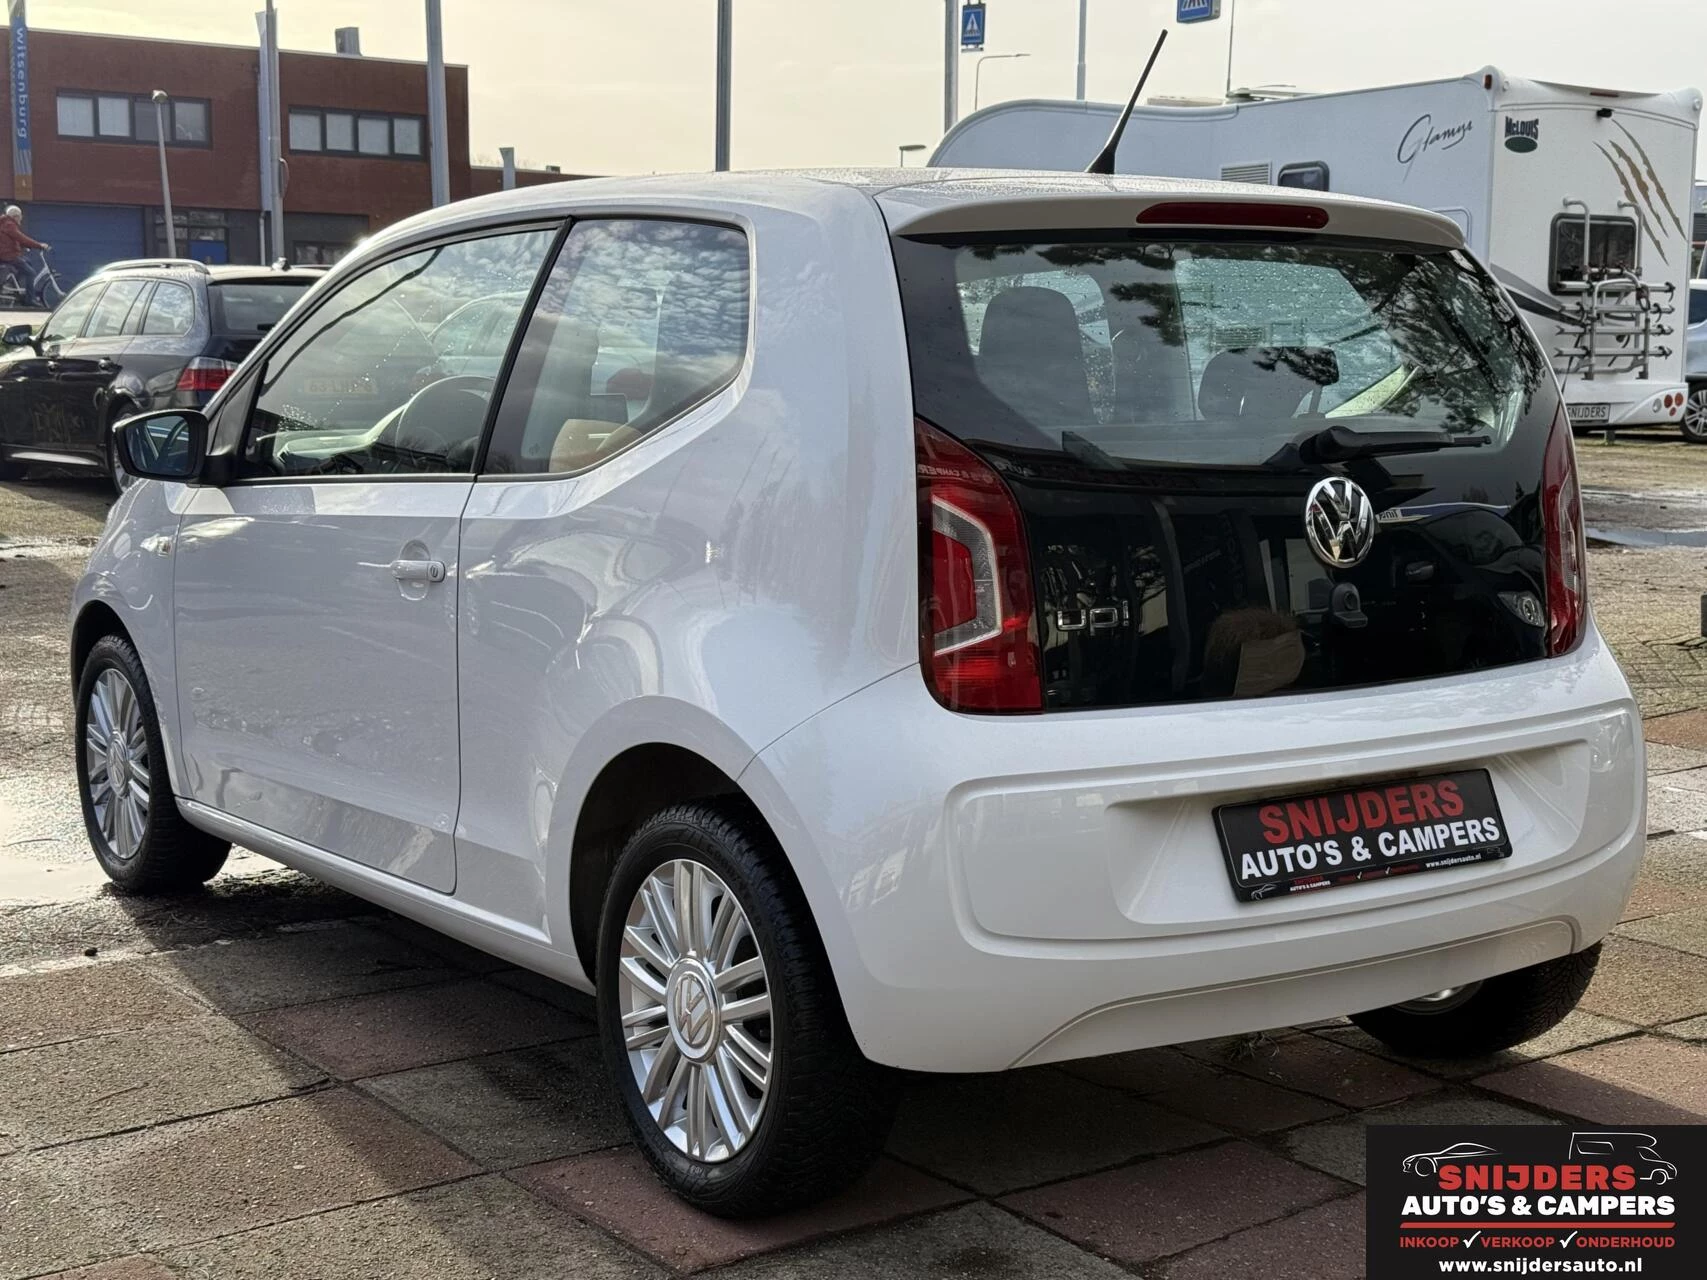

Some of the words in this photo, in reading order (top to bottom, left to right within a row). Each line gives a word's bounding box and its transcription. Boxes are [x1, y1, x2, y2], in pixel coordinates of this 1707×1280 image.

[16, 28, 28, 139] witsenburg
[1567, 406, 1606, 418] SNIJDERS
[1058, 600, 1129, 636] up!
[1258, 780, 1465, 844] SNIJDERS
[1241, 839, 1343, 880] AUTO'S
[1351, 836, 1372, 861] &
[1378, 817, 1500, 857] CAMPERS
